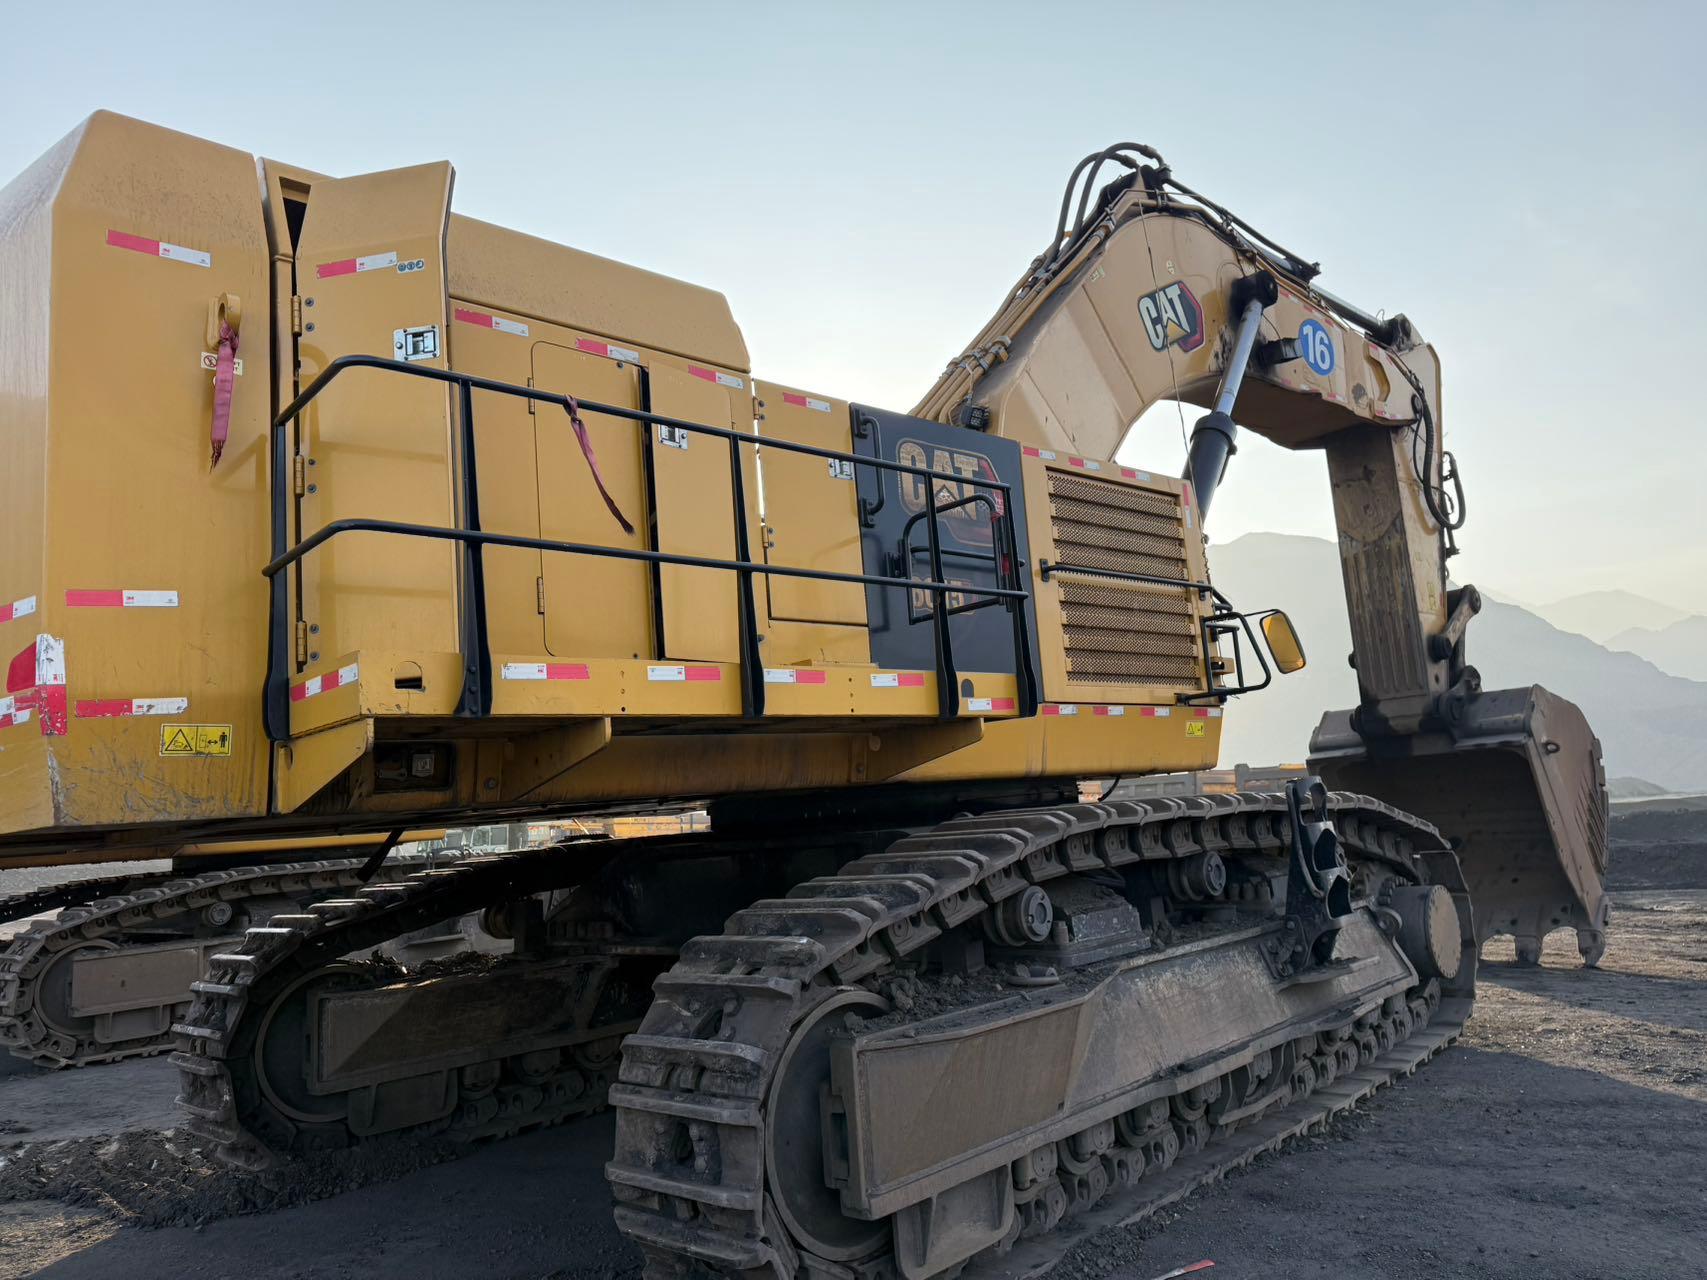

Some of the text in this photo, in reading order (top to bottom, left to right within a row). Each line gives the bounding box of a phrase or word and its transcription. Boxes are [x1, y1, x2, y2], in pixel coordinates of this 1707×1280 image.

[1138, 283, 1190, 349] CAT
[1302, 324, 1331, 370] 16
[900, 442, 979, 521] CAT
